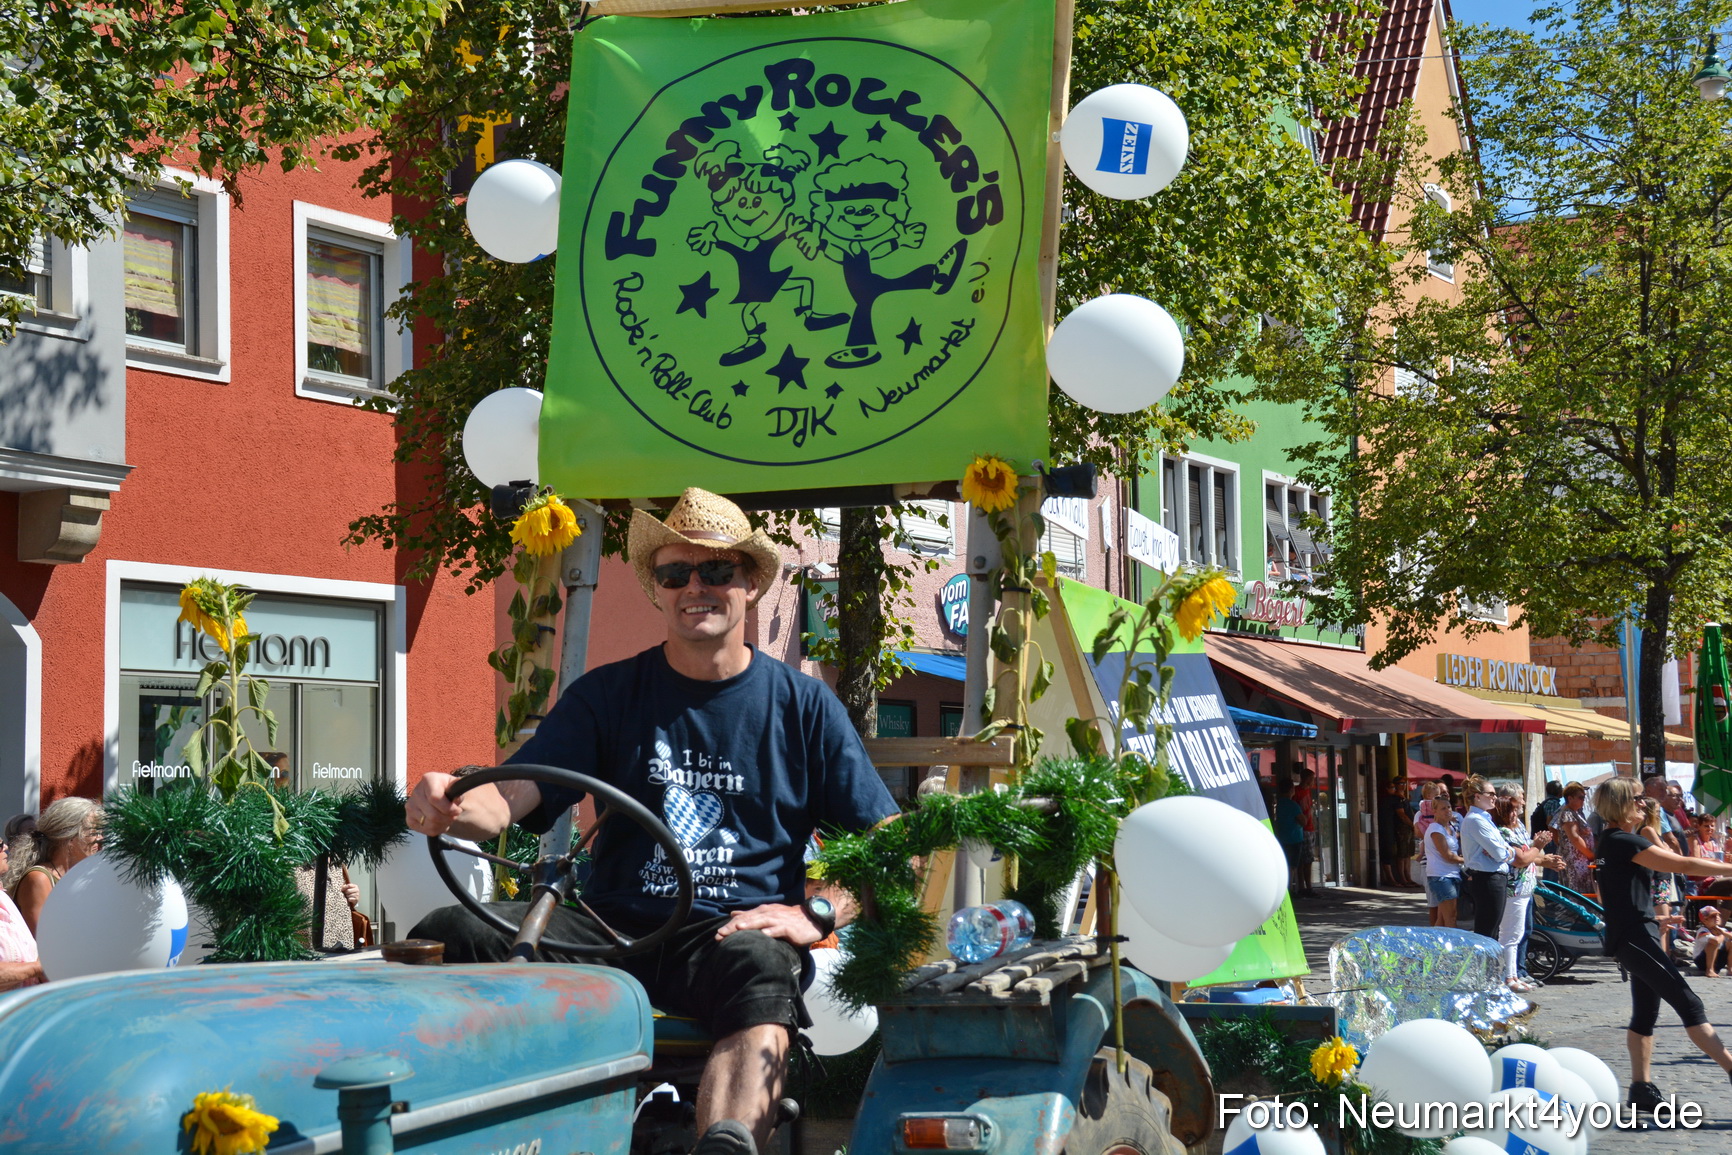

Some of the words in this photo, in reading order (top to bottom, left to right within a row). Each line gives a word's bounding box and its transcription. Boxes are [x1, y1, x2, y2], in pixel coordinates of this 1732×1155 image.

[1119, 122, 1139, 174] ZEISS
[765, 403, 837, 448] DJK
[858, 317, 976, 418] Neumarkt
[940, 579, 967, 605] vom
[1251, 580, 1307, 628] Bögerl
[1445, 653, 1483, 688] LEDER
[1488, 658, 1558, 695] ROMSTÖCK
[879, 715, 910, 735] Whisky
[132, 760, 191, 778] fielmann
[312, 762, 363, 779] fielmann
[648, 758, 745, 792] Bayern
[719, 756, 732, 771] in
[654, 839, 735, 865] georen
[704, 866, 727, 877] BIN
